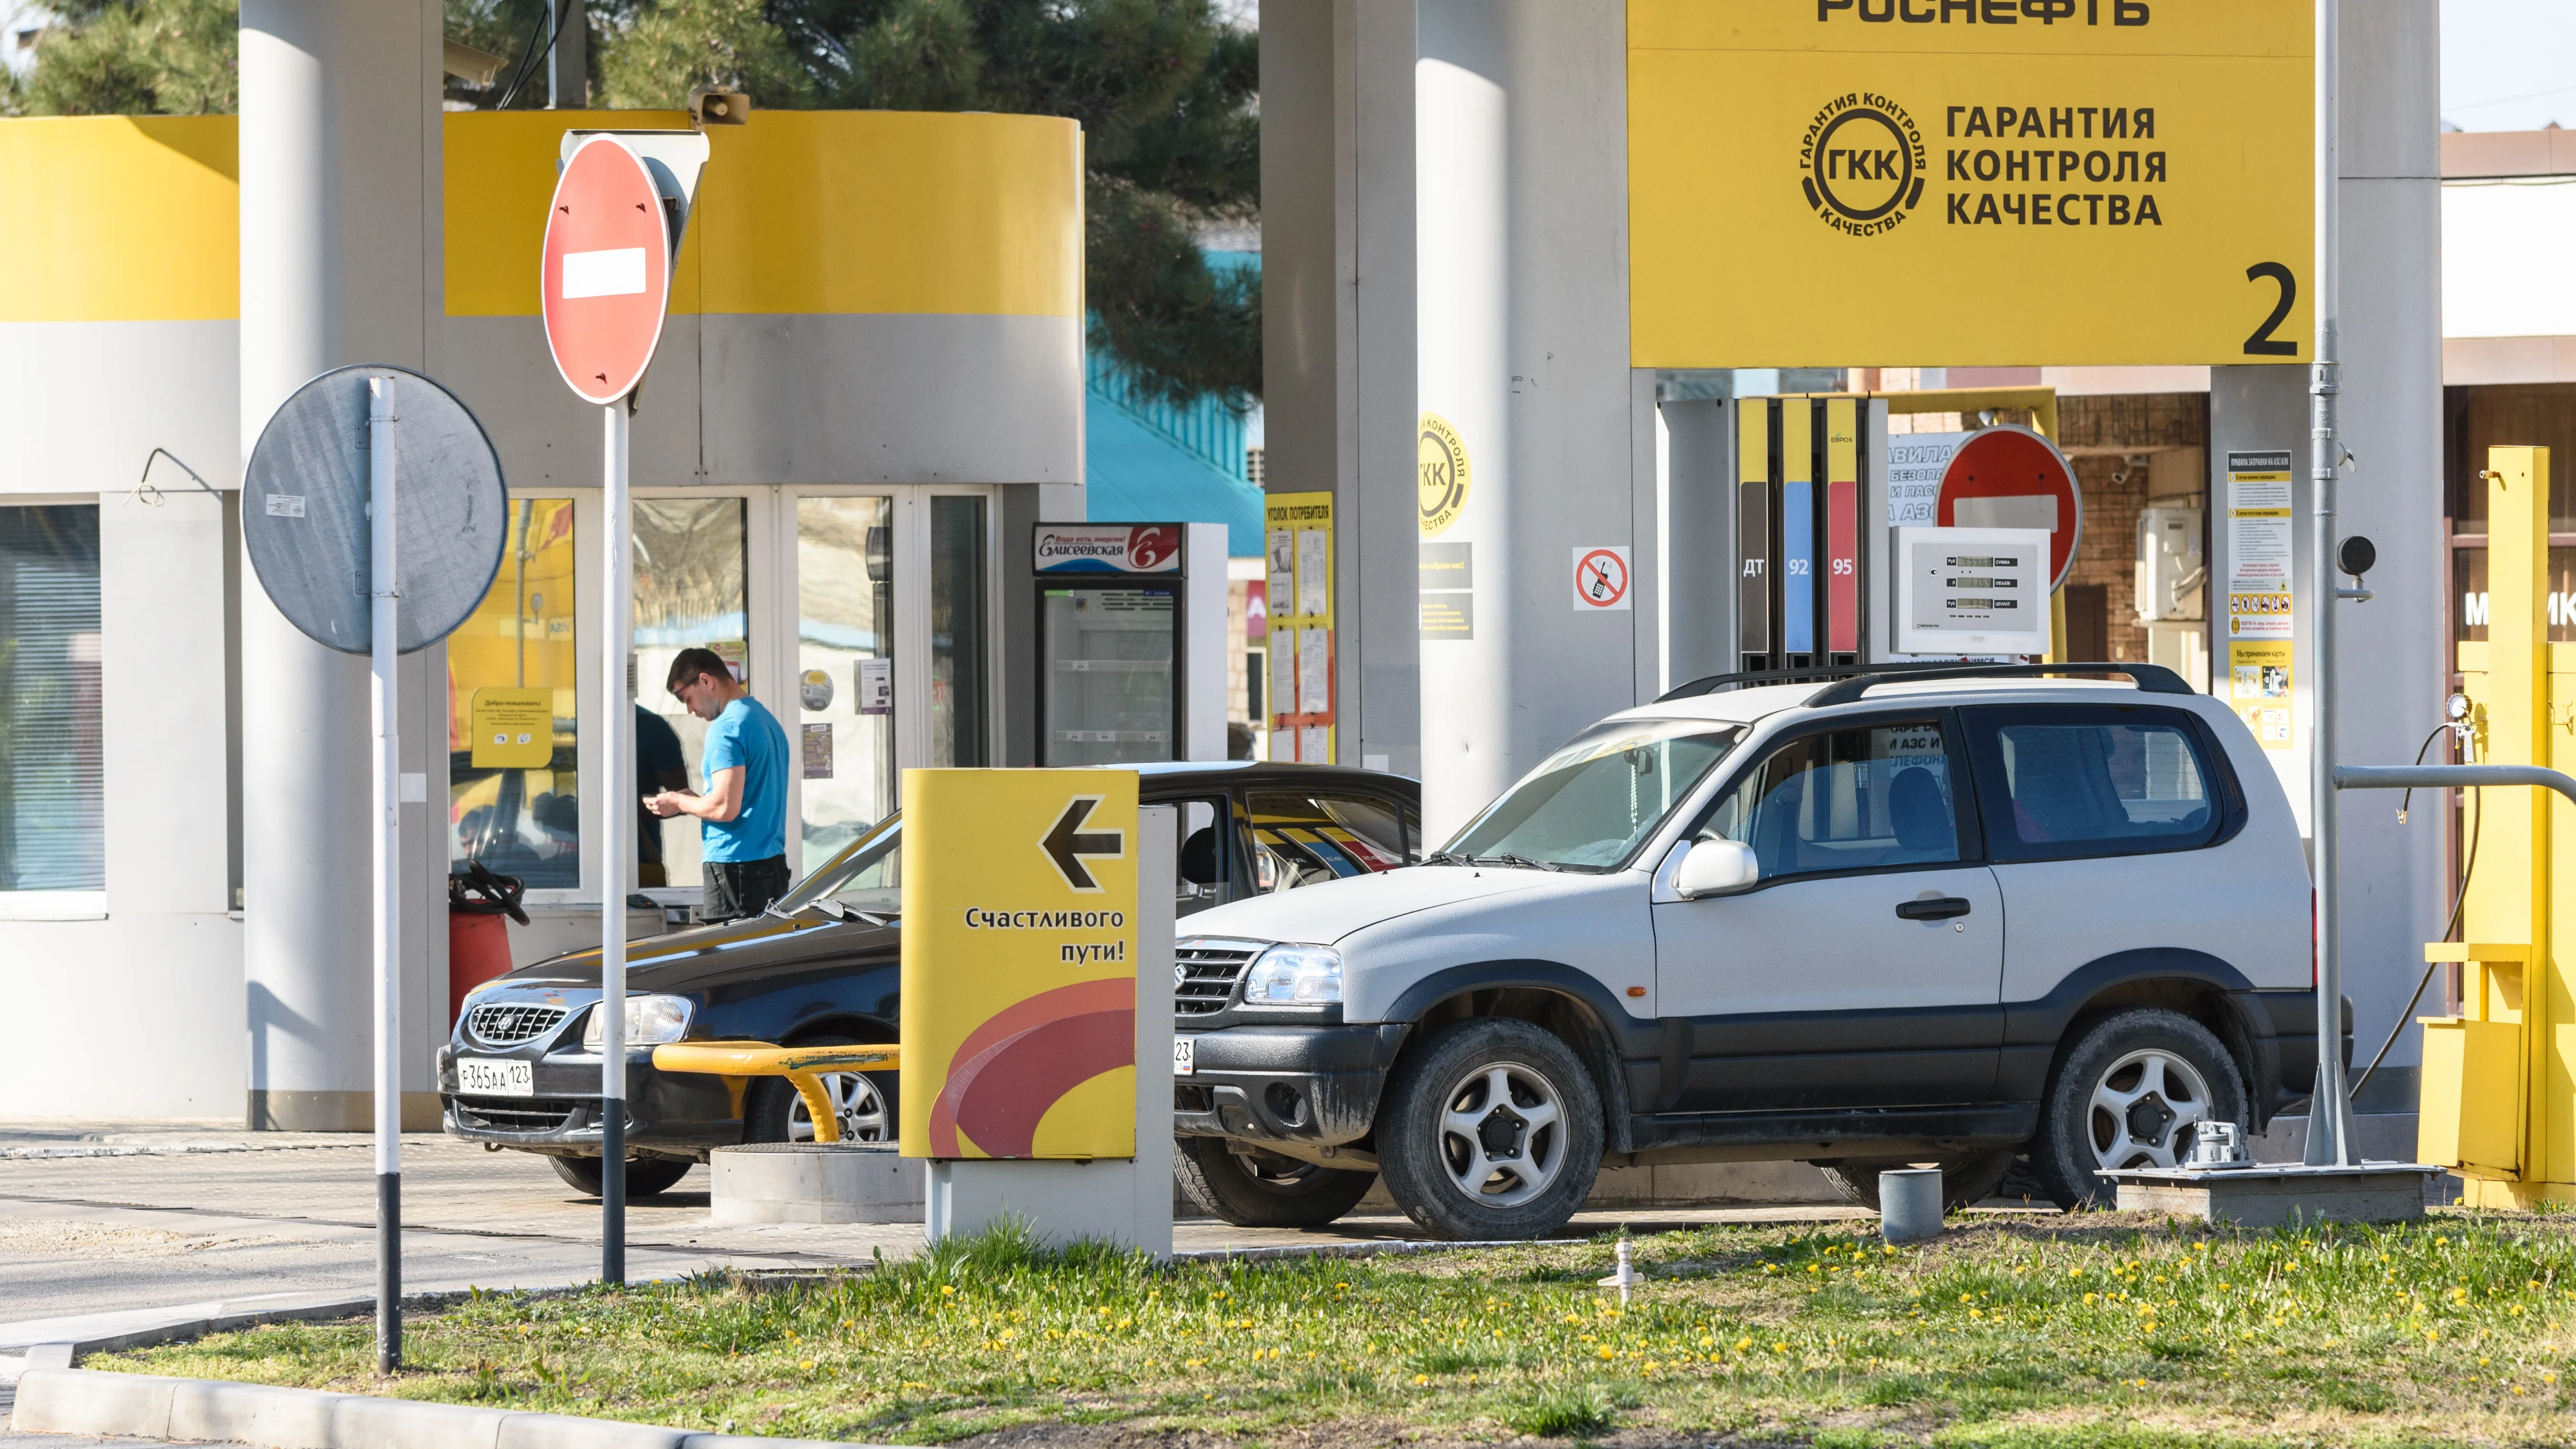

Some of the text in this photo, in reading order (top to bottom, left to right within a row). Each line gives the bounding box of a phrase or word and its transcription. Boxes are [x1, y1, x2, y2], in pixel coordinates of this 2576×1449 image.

[1799, 93, 1926, 171] ГАРАНТИЯ КОНТРОЛЯ
[1946, 106, 2155, 139] ГАРАНТИЯ
[1828, 149, 1900, 180] ГКК
[1946, 149, 2167, 183] КОНТРОЛЯ
[1946, 193, 2163, 226] КАЧЕСТВА
[1819, 208, 1907, 238] КАЧЕСТВА
[2243, 261, 2298, 356] 2
[1427, 418, 1465, 477] КОНТРОЛЯ
[1890, 486, 1902, 498] И
[1267, 505, 1329, 521] УГОЛОК ПОТРЕБИТЕЛЯ
[1743, 559, 1765, 577] ДТ
[1789, 559, 1809, 575] 92
[1832, 558, 1852, 575] 95
[1901, 738, 1927, 750] АЗС
[966, 907, 1124, 928] Счастливого
[1061, 940, 1124, 965] пути!
[509, 1065, 529, 1083] 123
